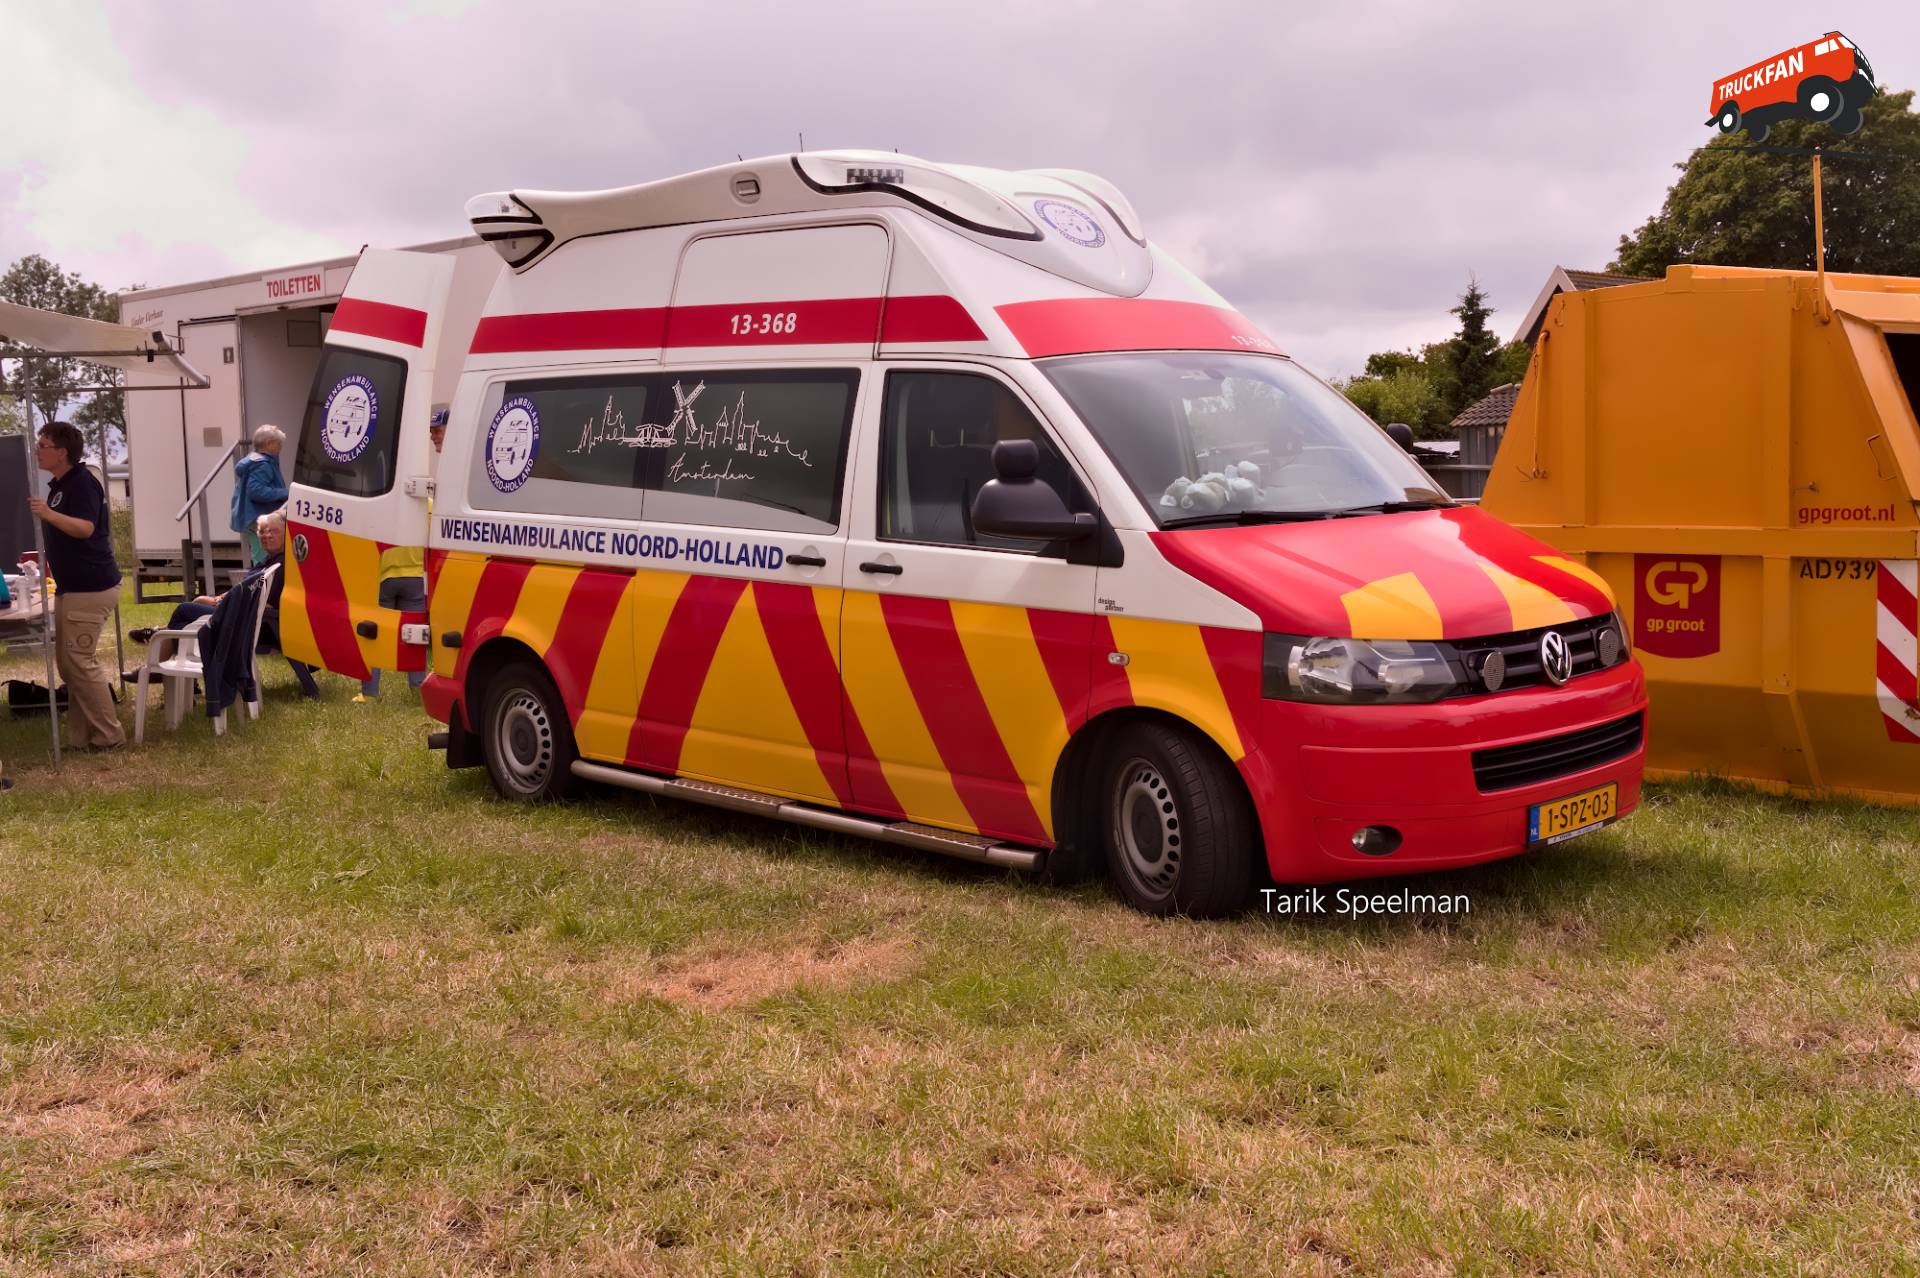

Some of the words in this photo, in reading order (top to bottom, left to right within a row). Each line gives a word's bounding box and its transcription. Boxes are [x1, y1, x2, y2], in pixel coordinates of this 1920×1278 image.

[266, 274, 321, 298] TOILETTEN
[731, 312, 797, 335] 13-368
[324, 375, 378, 420] WENSENAMBULANCE
[488, 396, 540, 440] WENSENAMBULANCE
[321, 428, 370, 463] NOORD-HOLLAND
[487, 458, 534, 492] NOORD-HOLLAND
[667, 452, 756, 483] Amsterdam
[296, 499, 344, 525] 13-368
[1798, 503, 1896, 525] gpgroot.nl
[440, 518, 606, 554] WENSENAMBULANCE
[611, 532, 785, 570] NOORD-HOLLAND
[1646, 618, 1665, 633] gp
[1666, 618, 1705, 633] groot
[1548, 791, 1609, 833] 1-SPZ-03
